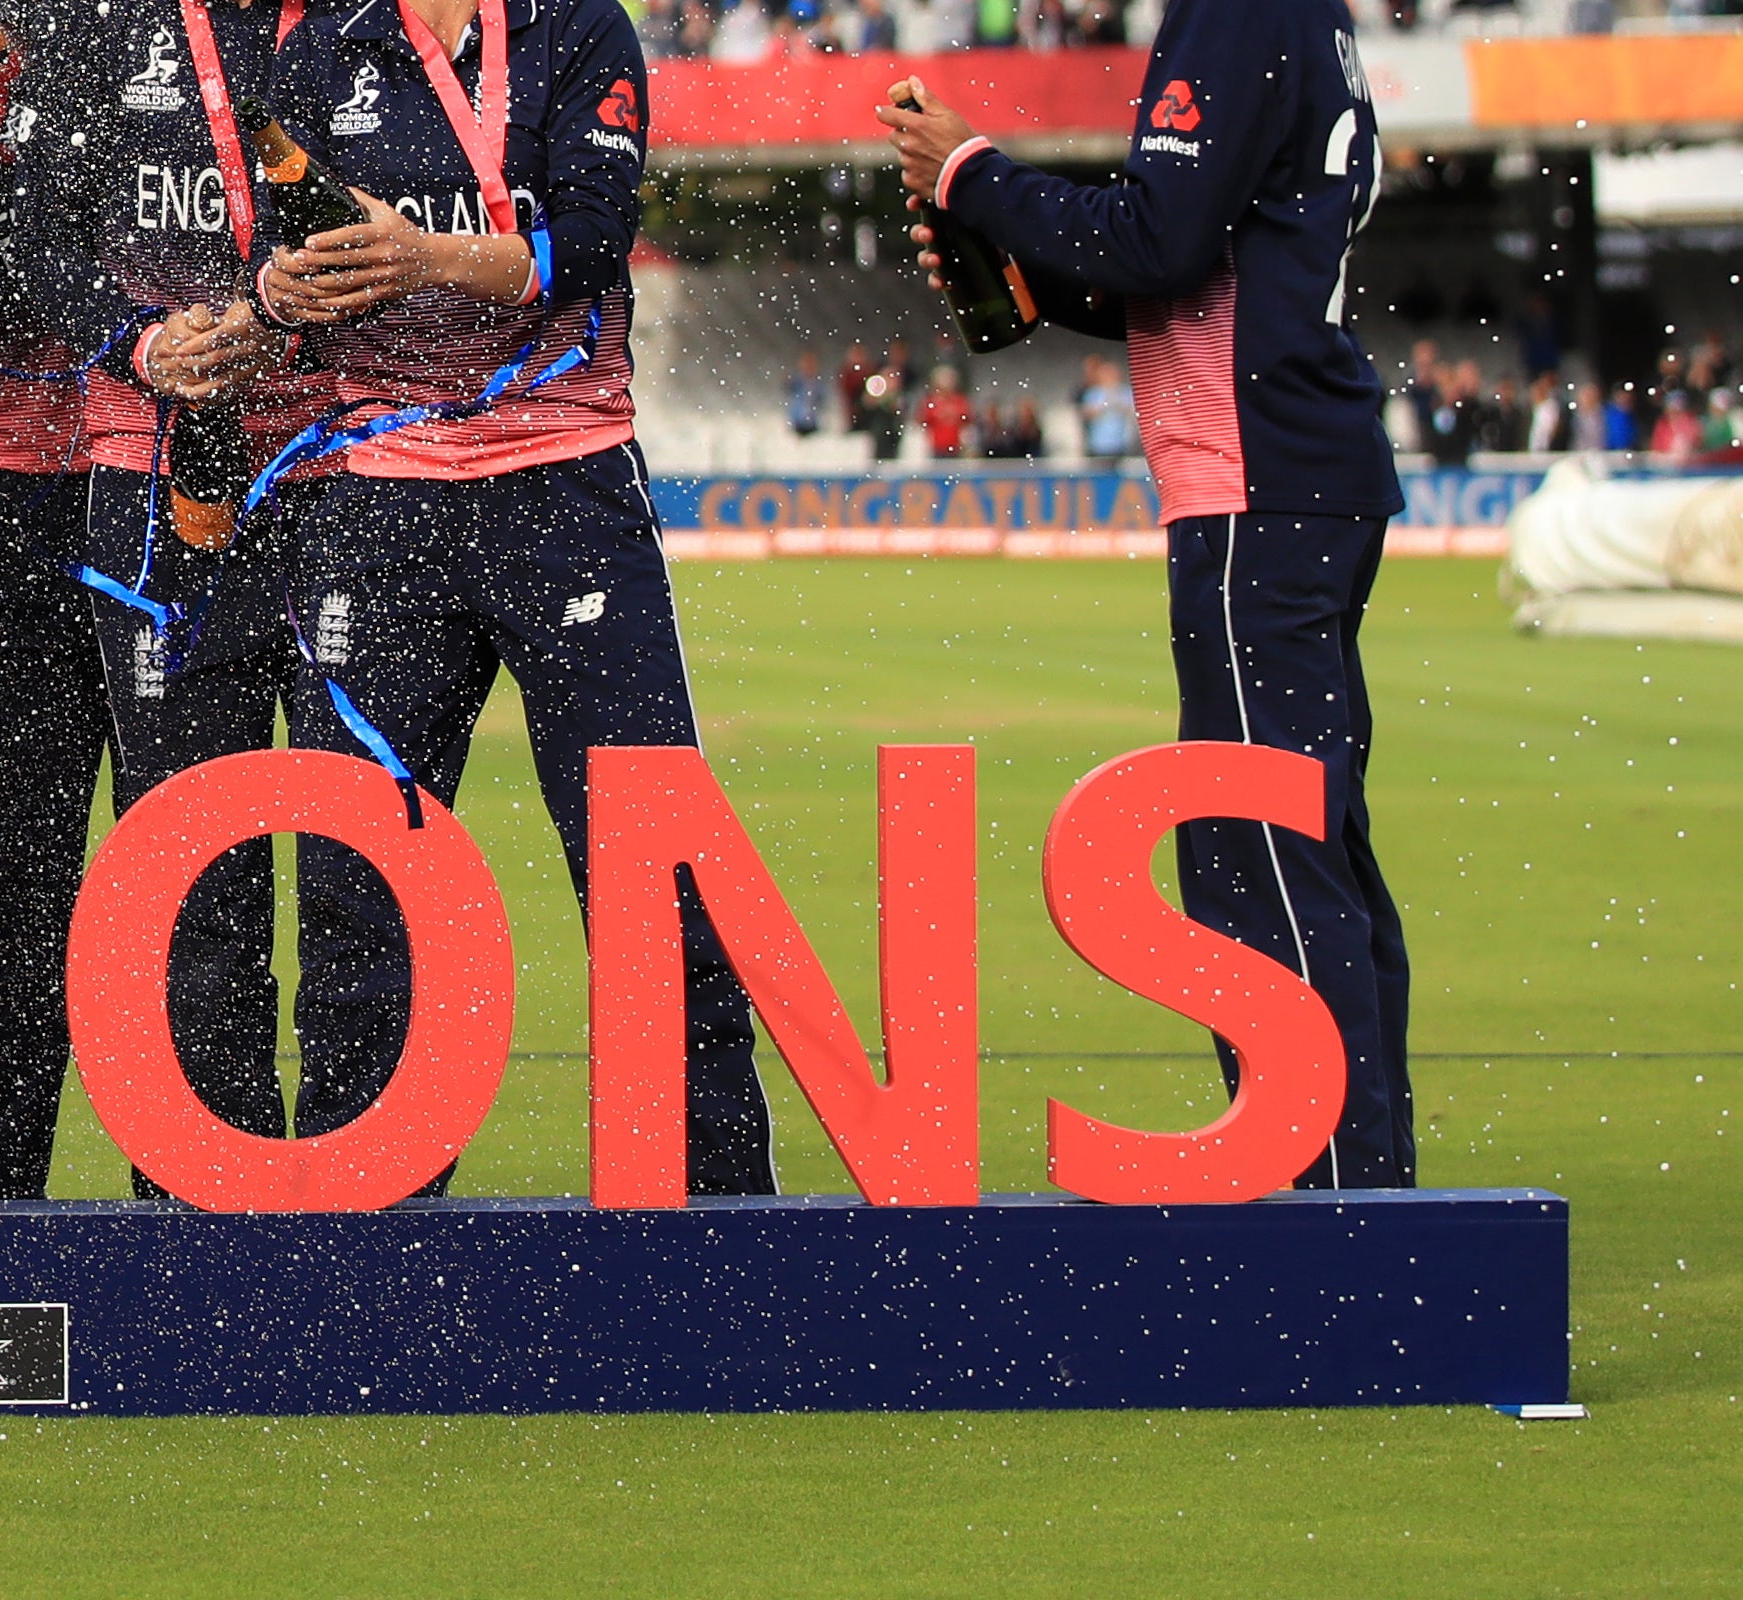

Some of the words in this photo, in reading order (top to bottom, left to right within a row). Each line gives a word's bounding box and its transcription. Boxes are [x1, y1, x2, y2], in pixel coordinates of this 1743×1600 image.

[125, 84, 180, 97] WOMEN'S
[121, 93, 161, 105] WORLD
[162, 96, 185, 106] CUP
[332, 112, 379, 121] WOMEN'S
[329, 120, 362, 131] WORLD
[362, 120, 382, 129] CUP
[1141, 135, 1200, 157] NatWest
